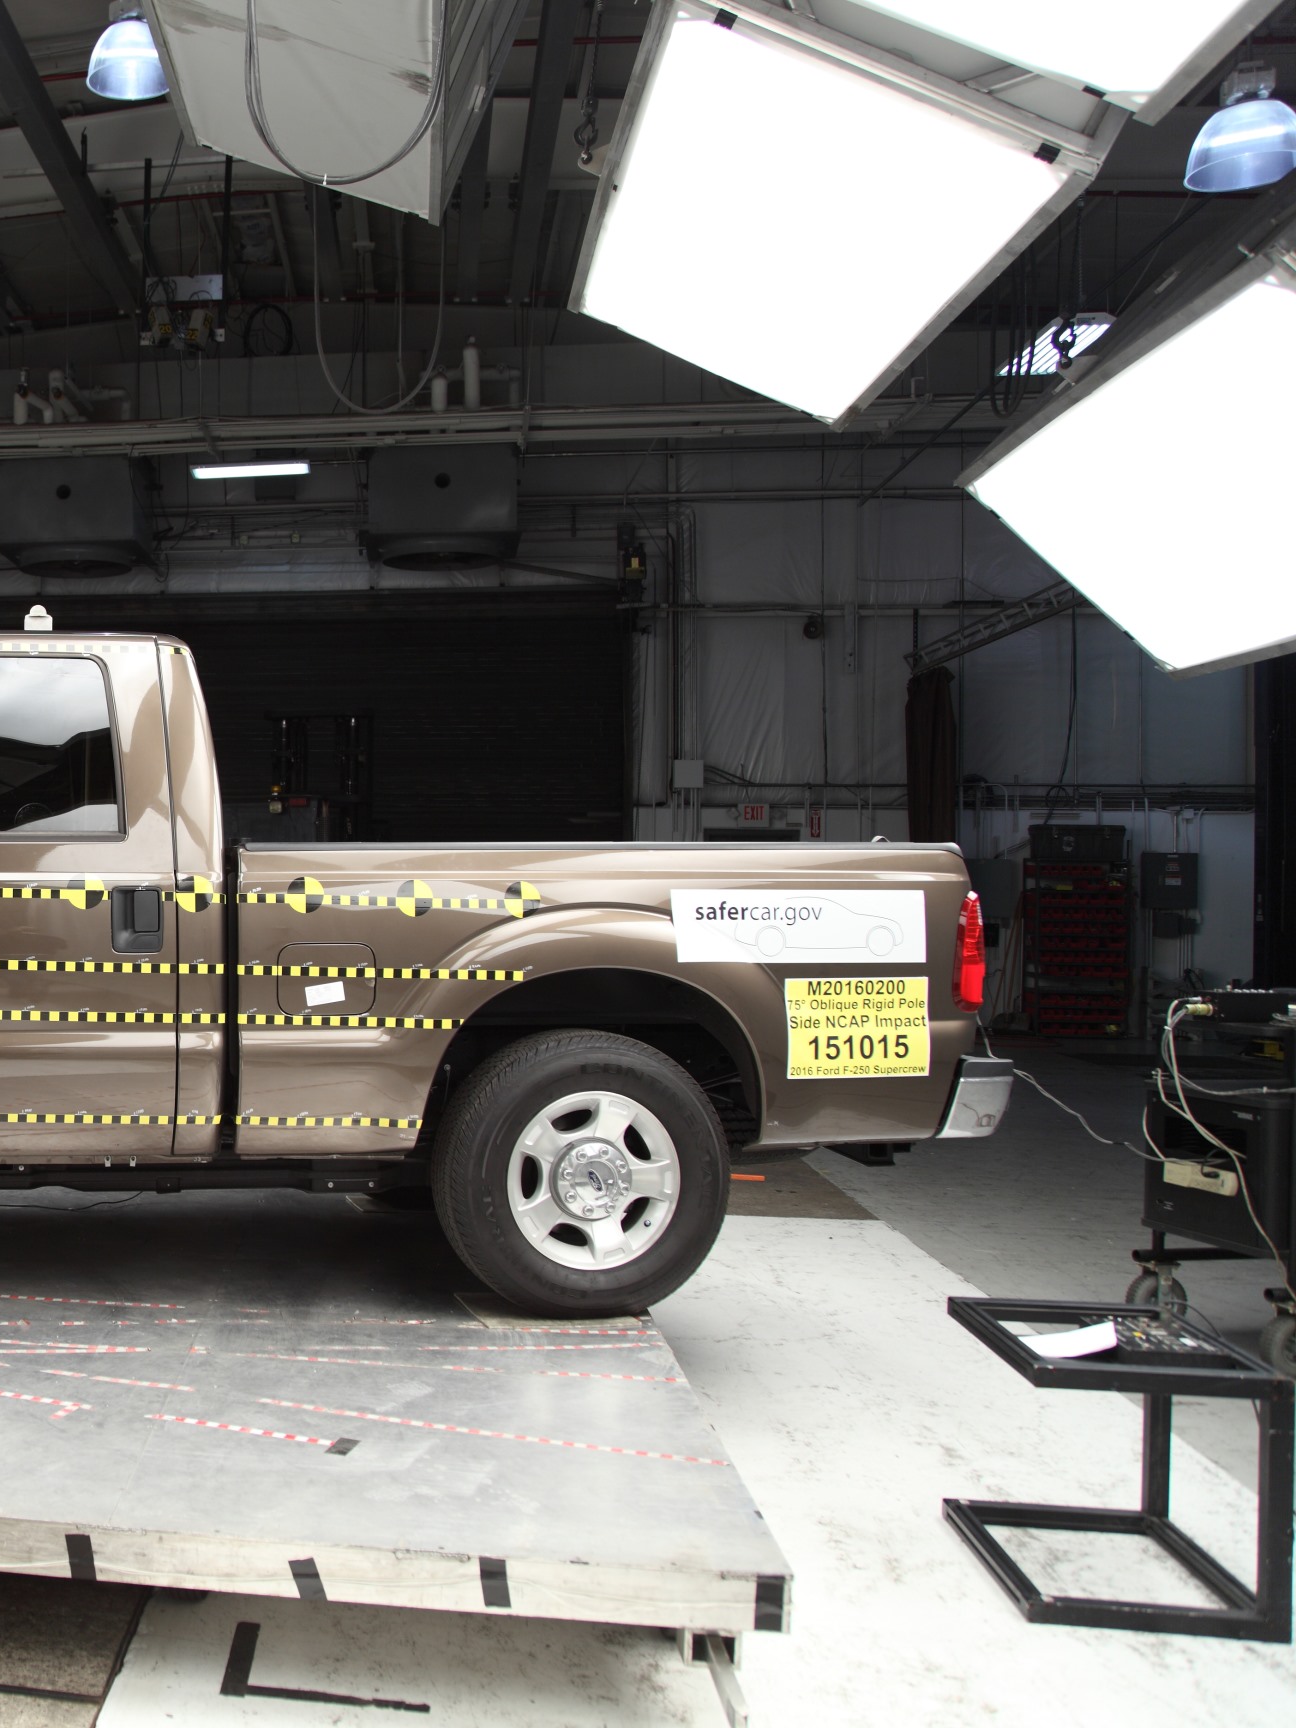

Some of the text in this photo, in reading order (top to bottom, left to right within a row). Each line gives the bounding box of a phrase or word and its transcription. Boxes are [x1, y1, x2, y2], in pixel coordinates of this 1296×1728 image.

[743, 805, 765, 821] EXIT
[695, 900, 822, 926] safercar.gov
[807, 979, 906, 996] M20160200
[810, 999, 859, 1012] Oblique
[862, 998, 894, 1011] Rigid
[898, 998, 926, 1009] Pole
[790, 1014, 927, 1030] Side NCAP Impact
[808, 1034, 909, 1060] 151015
[790, 1065, 927, 1076] 2016 Ford F-250 Supercrew
